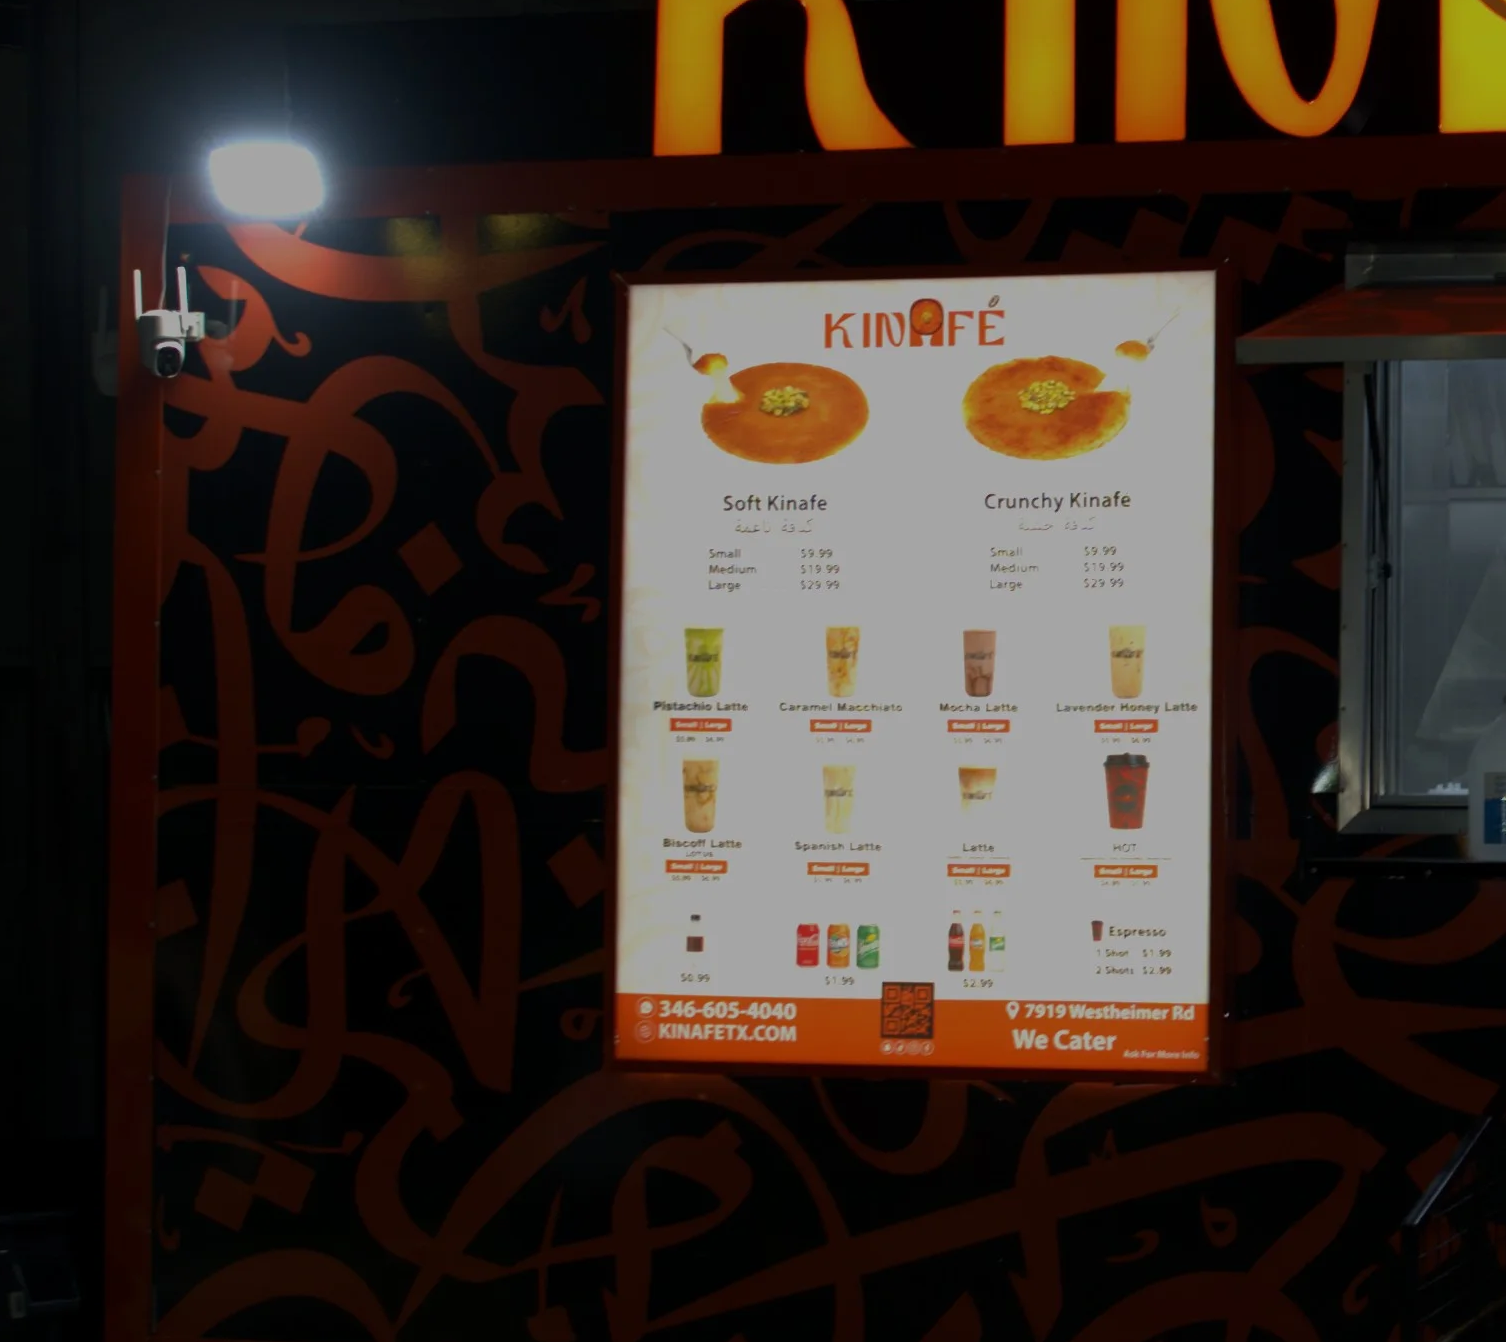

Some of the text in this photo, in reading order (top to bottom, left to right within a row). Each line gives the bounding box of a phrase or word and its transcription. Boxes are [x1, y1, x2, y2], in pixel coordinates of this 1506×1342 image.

[824, 295, 1005, 348] KINAFÉ
[723, 495, 828, 511] Soft Kinafe
[984, 491, 1131, 512] Crunchy Kinafe
[708, 548, 833, 560] Small $9.99
[990, 546, 1117, 558] Small $9.99
[708, 563, 840, 575] Medium $19.99
[990, 562, 1125, 574] Medium $19.99
[708, 579, 840, 591] Large $29.99
[990, 578, 1124, 591] Large $29.99
[653, 701, 749, 712] Pistachio Latte
[779, 702, 903, 712] Caramel Macchiato
[939, 702, 1019, 713] Mocha Latte
[1056, 702, 1198, 714] Lavender Honey Latte
[662, 838, 743, 849] Biscoff Latte
[794, 841, 882, 852] Spanish Latte
[962, 843, 995, 852] Latte
[1109, 926, 1167, 938] Espresso
[658, 1000, 798, 1020] 346-605-4040
[1024, 1003, 1196, 1021] 7919 Westheimer Rd
[658, 1023, 798, 1042] KINAFETX.COM
[1012, 1029, 1118, 1051] We Cater
